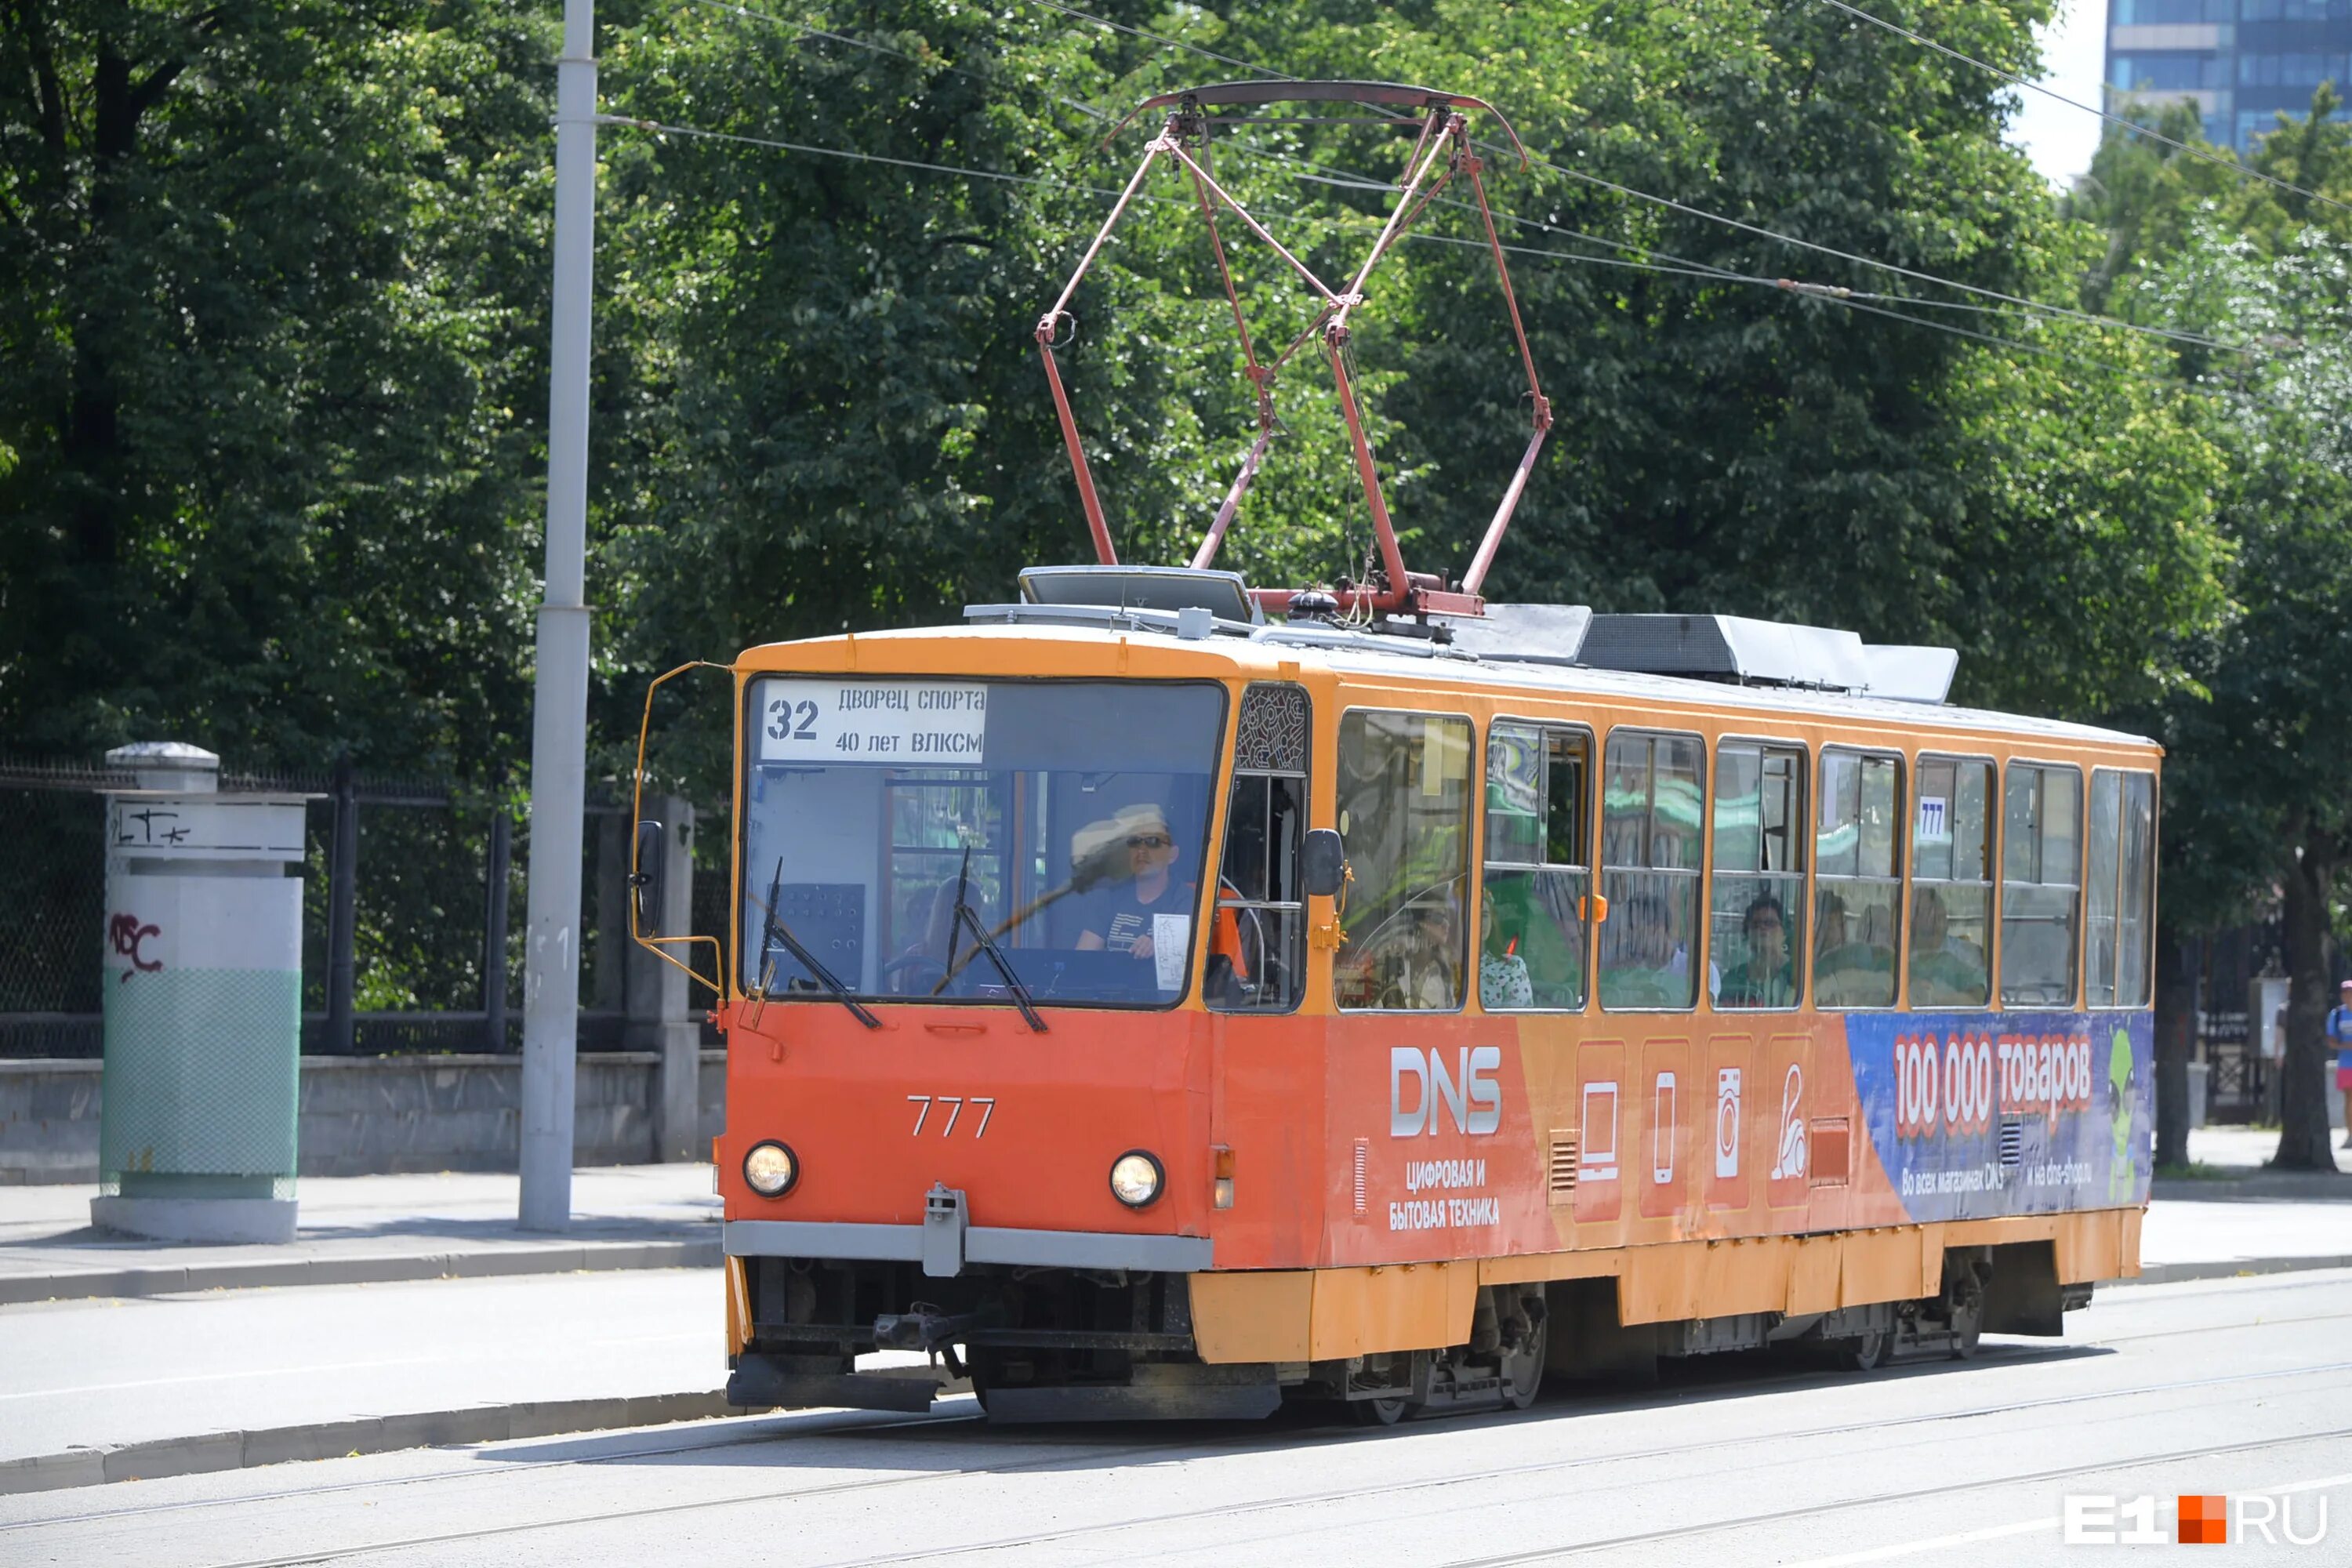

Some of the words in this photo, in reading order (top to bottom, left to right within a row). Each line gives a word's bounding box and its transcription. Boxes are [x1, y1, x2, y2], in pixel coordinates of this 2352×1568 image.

[767, 699, 819, 740] 32
[835, 732, 860, 752] 40
[867, 735, 901, 752] лет
[911, 733, 982, 753] ВЛКСМ
[1922, 804, 1943, 835] 777
[1390, 1046, 1501, 1137] DNS
[1896, 1041, 1939, 1125] 100
[1944, 1040, 1992, 1123] 000
[1998, 1042, 2091, 1123] товаров
[907, 1094, 996, 1138] 777
[1406, 1160, 1473, 1195] ЦИФРОВАЯ
[1476, 1159, 1486, 1186] И
[1902, 1167, 1914, 1196] Во
[1915, 1172, 1936, 1195] всех
[1985, 1162, 2004, 1190] DNS
[1390, 1200, 1445, 1231] БЫТОВАЯ
[1448, 1197, 1499, 1228] ТЕХНИКА
